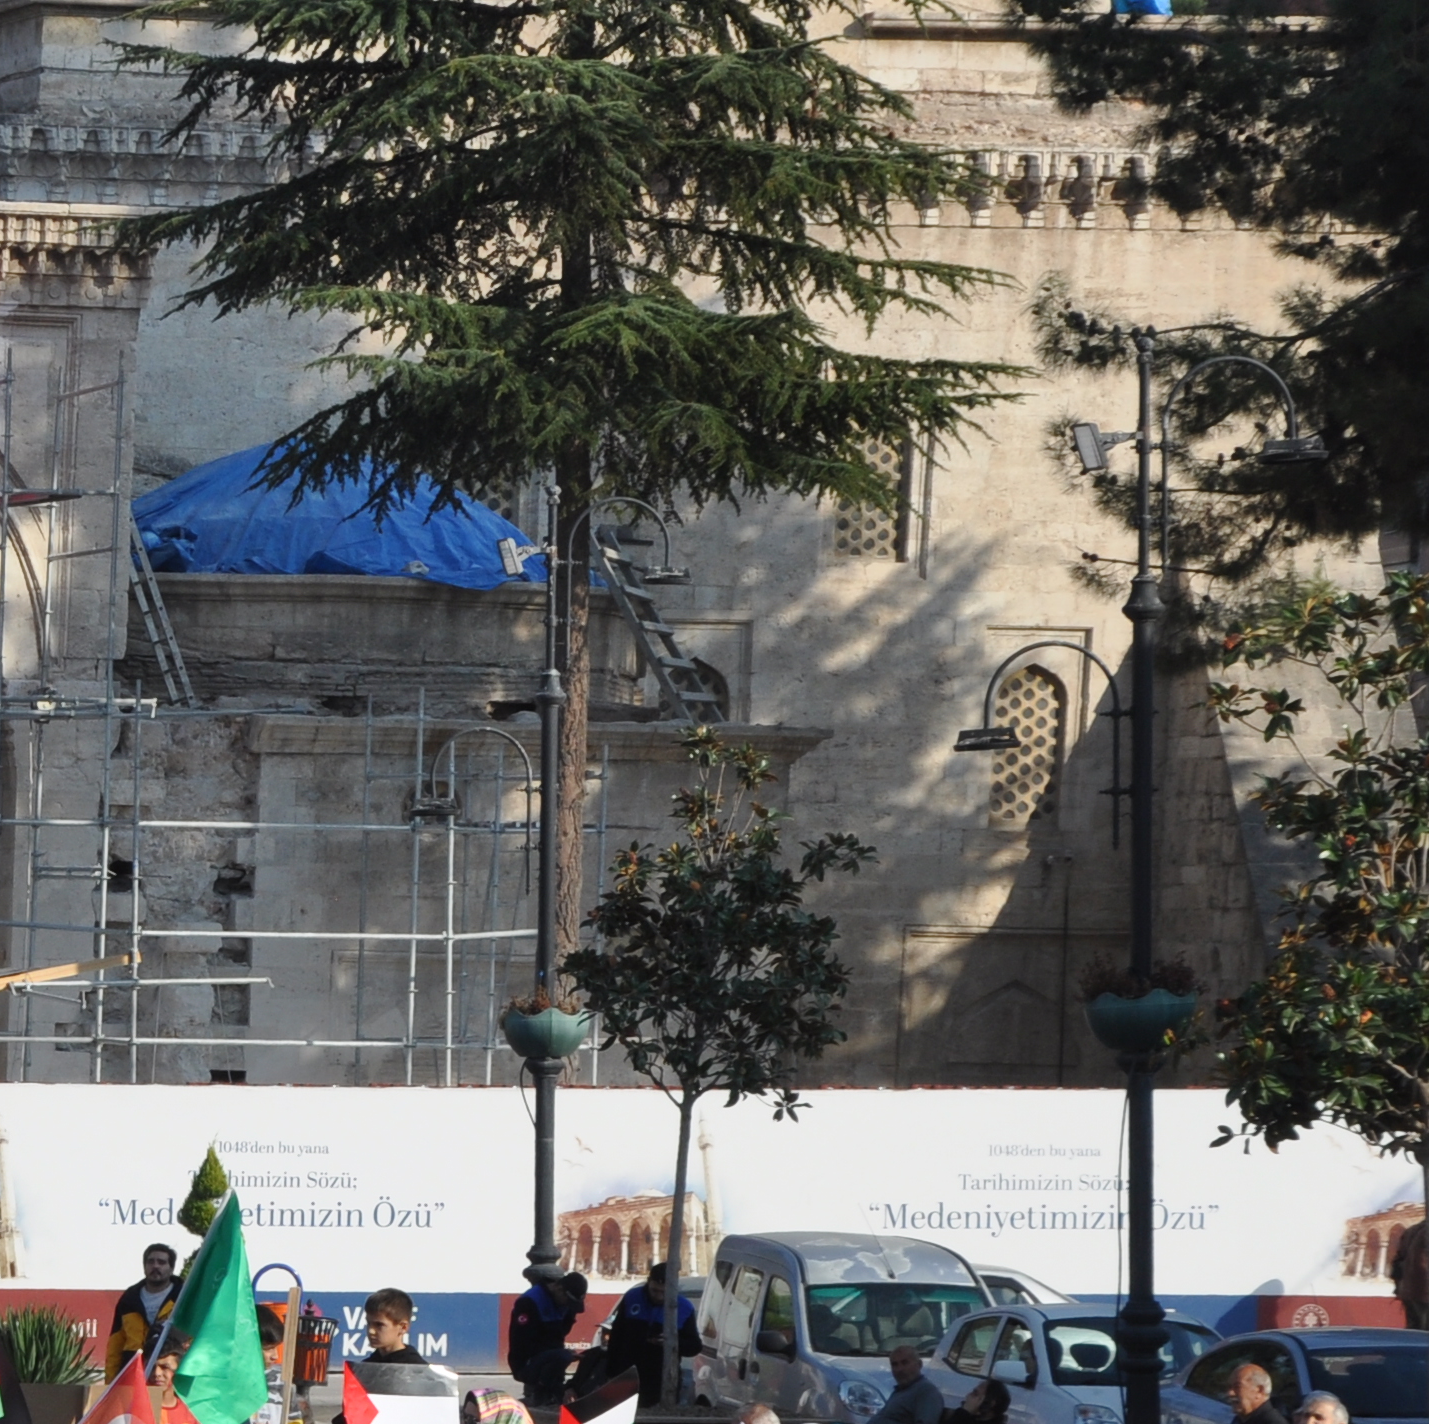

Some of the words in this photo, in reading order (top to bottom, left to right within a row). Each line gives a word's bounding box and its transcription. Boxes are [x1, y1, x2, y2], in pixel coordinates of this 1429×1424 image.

[278, 1141, 296, 1154] bu
[297, 1144, 330, 1157] yana
[1049, 1144, 1066, 1157] bu
[1068, 1147, 1101, 1160] yana
[306, 1170, 358, 1190] Sözü;
[958, 1173, 1074, 1192] Tarihimizin
